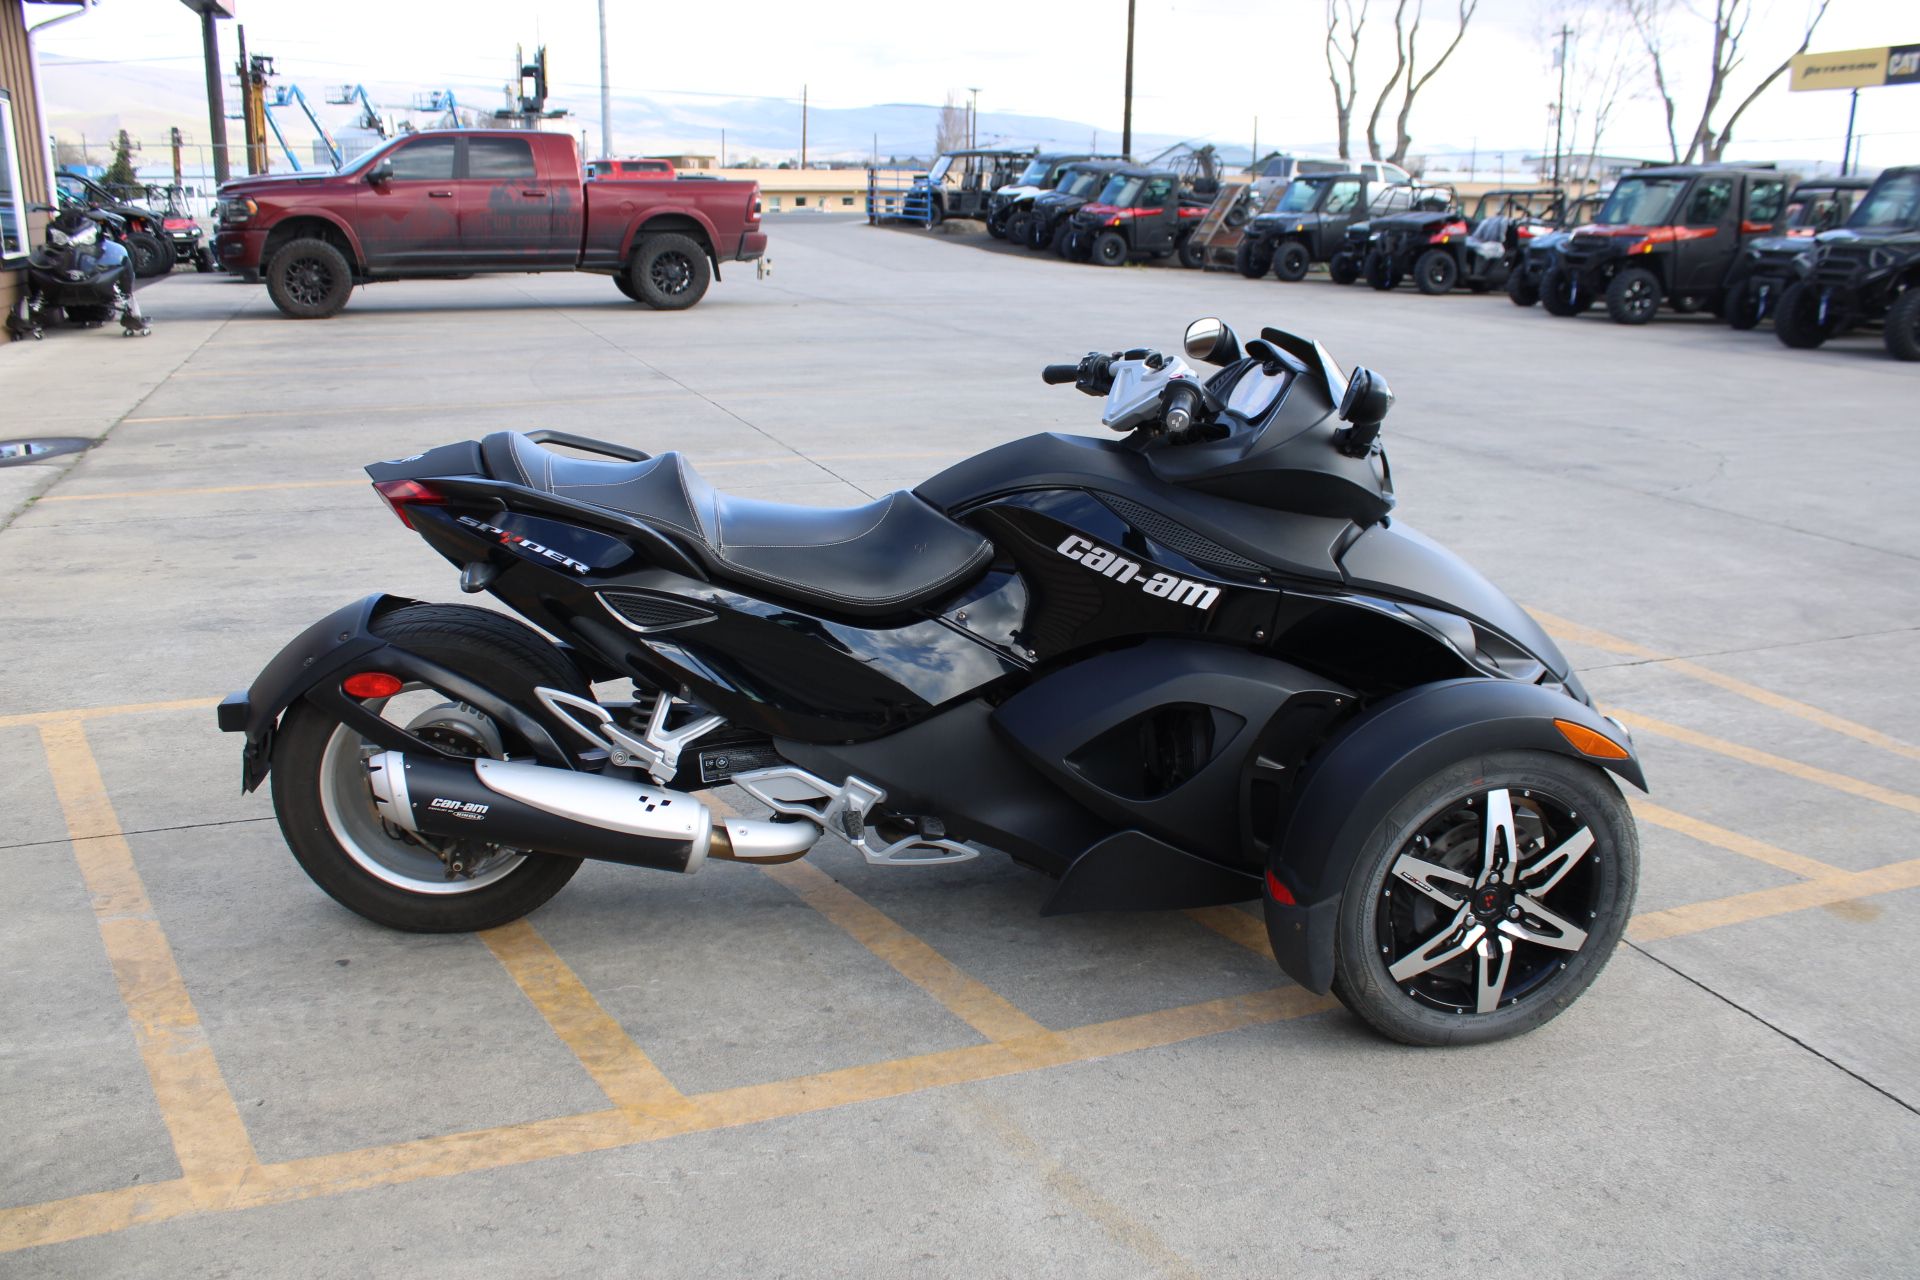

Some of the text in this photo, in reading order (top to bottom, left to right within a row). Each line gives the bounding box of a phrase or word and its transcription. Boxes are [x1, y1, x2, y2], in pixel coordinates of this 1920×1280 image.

[1889, 52, 1920, 76] CAT
[456, 515, 591, 575] SPYDER
[1056, 534, 1221, 610] can-am
[431, 798, 489, 814] can-am
